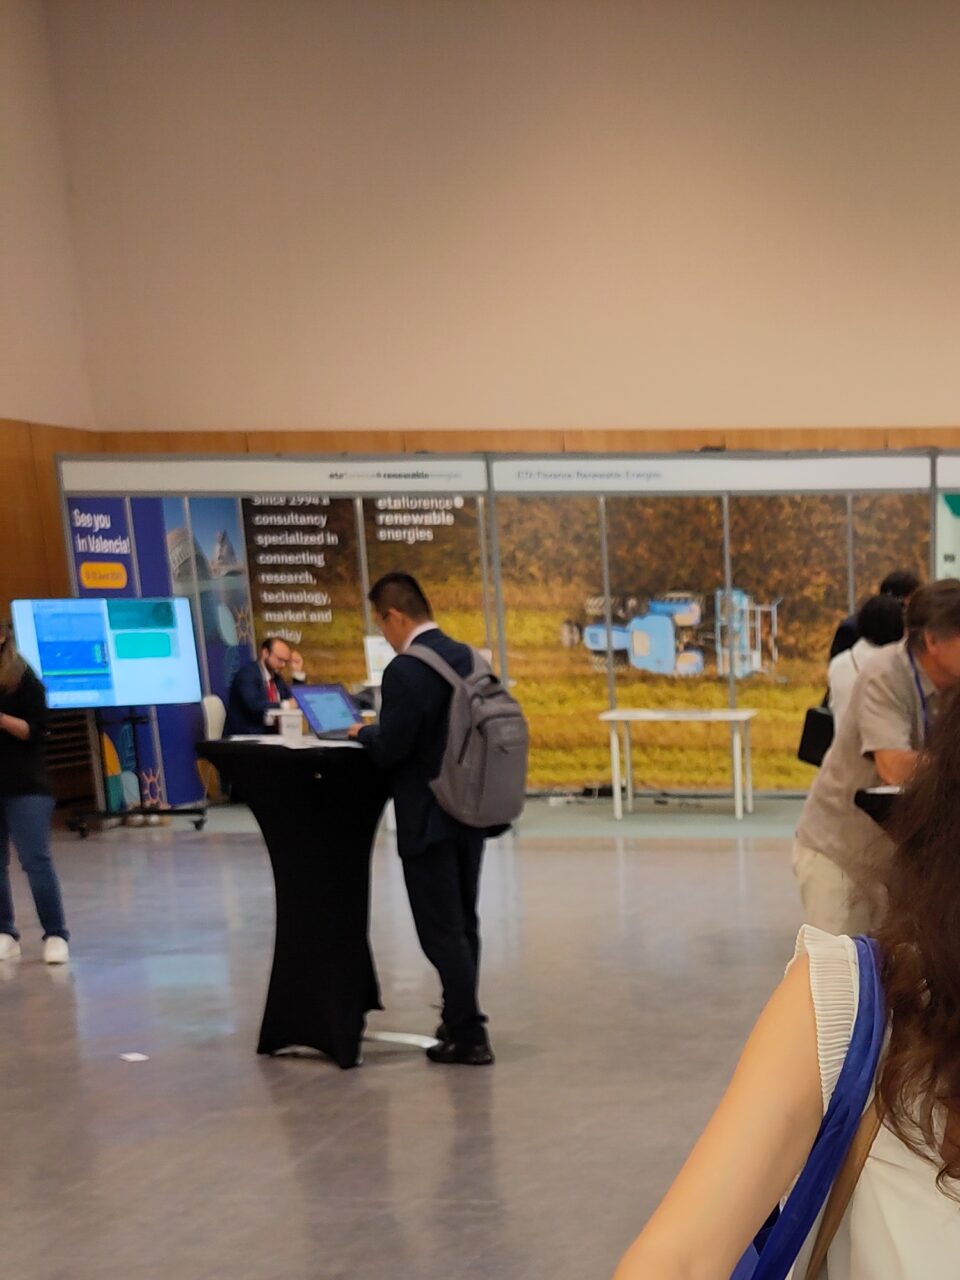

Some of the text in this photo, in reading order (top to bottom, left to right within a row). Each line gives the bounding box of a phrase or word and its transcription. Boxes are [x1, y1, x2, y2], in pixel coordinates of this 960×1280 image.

[73, 508, 111, 532] See you
[253, 512, 327, 528] consultancy
[377, 510, 455, 526] renewable
[255, 531, 339, 547] specialized in
[377, 526, 434, 544] energies
[88, 534, 131, 555] Valencia!
[257, 552, 326, 568] connecting
[260, 571, 317, 585] research,
[261, 590, 331, 606] technology,
[263, 609, 332, 622] market and
